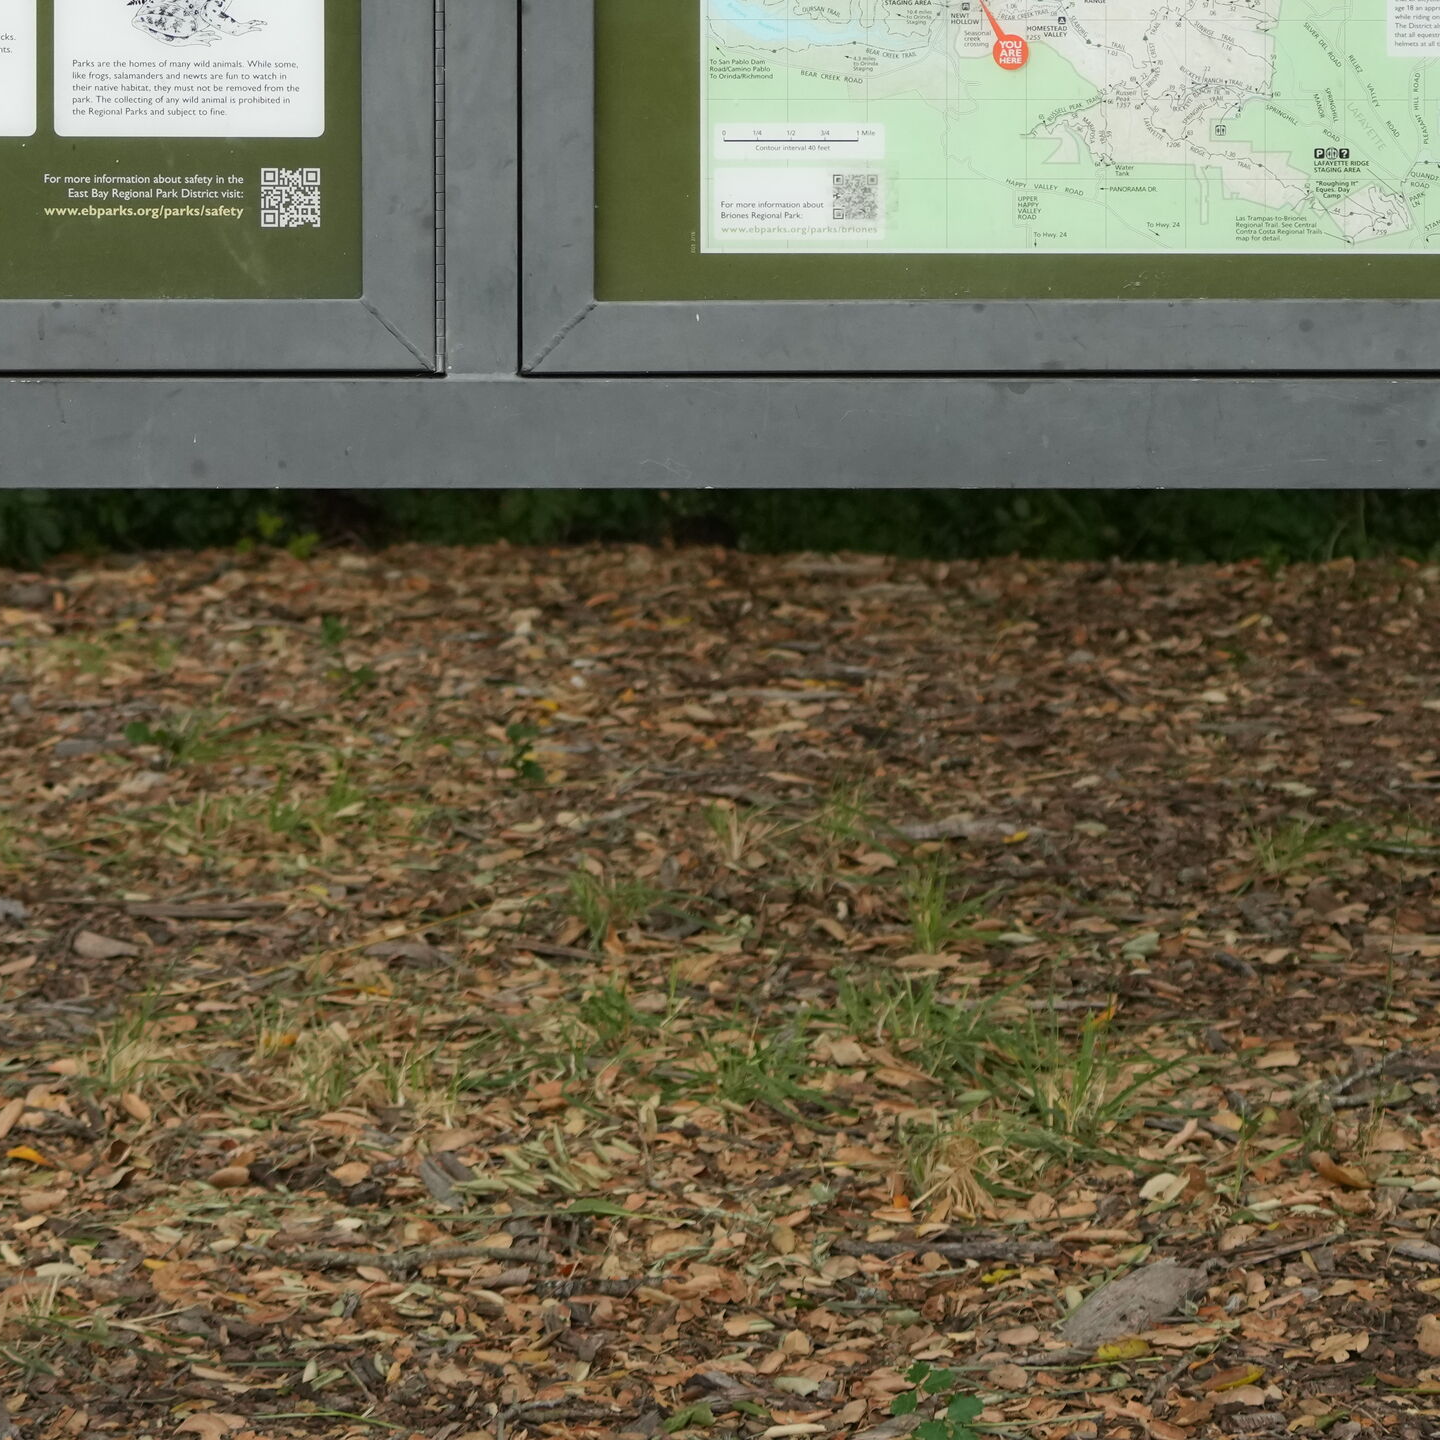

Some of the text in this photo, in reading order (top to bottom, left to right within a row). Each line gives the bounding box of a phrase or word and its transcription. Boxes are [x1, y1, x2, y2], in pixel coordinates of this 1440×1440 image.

[998, 40, 1023, 49] YOU
[999, 50, 1023, 58] ARE
[43, 173, 244, 187] For more information about safety in the
[68, 187, 244, 201] East Bay Regional Park District visit:
[43, 204, 244, 220] www.ebparks.org/parks/safety
[721, 225, 878, 236] www.ebparks.org/parks/briones
